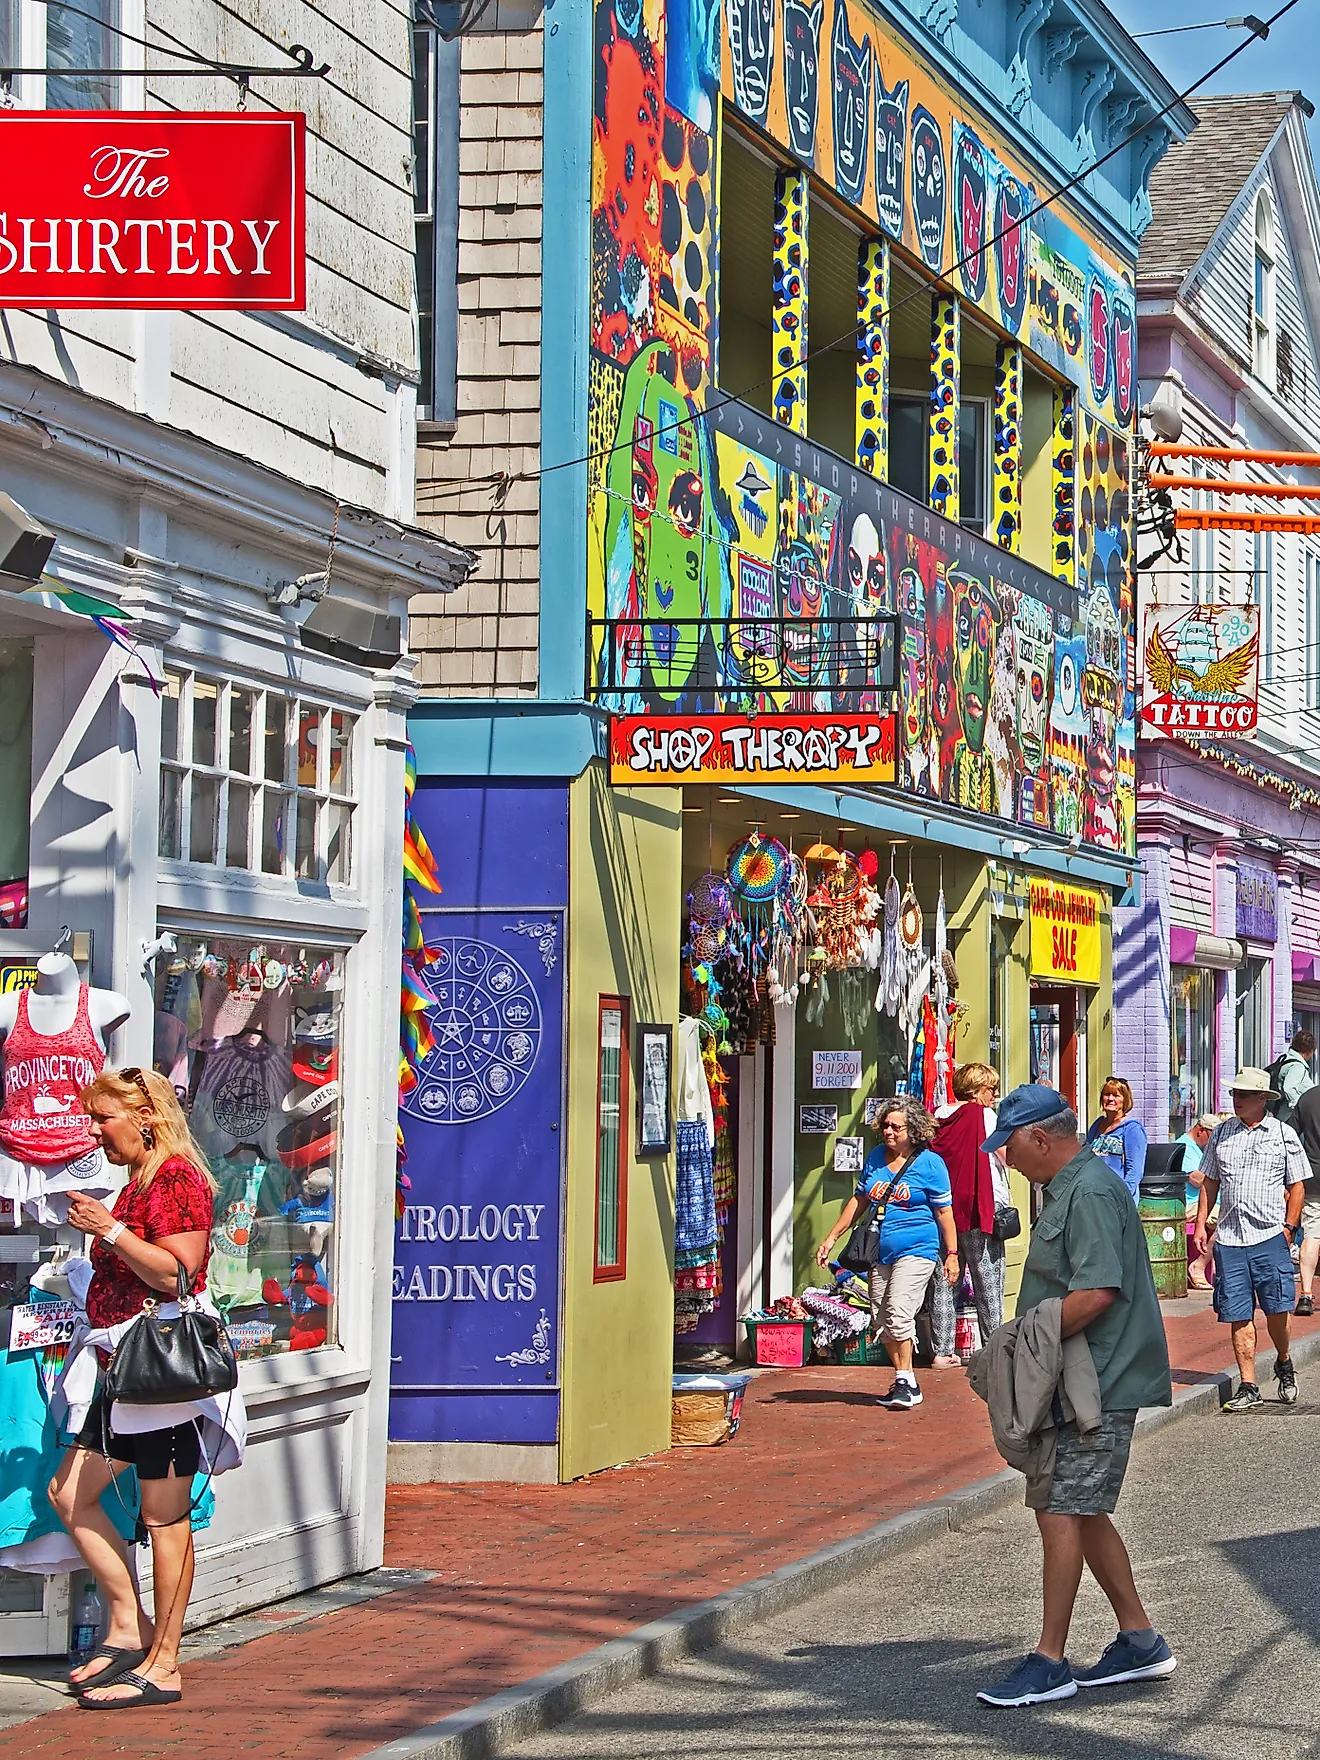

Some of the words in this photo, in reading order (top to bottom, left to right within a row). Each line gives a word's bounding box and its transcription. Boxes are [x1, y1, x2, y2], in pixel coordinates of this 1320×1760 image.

[83, 145, 170, 198] The
[0, 218, 280, 275] SHIRTERY
[795, 443, 859, 495] SHOP
[875, 488, 976, 562] THERAPY
[1151, 703, 1254, 728] TATTOO
[629, 726, 714, 772] SHOP
[720, 725, 881, 772] THERAPY
[1031, 883, 1050, 920] CAPE
[1052, 925, 1077, 972] SALE
[818, 1052, 850, 1062] NEVER
[815, 1075, 854, 1087] FORGET
[311, 1091, 327, 1109] CAPE
[400, 1204, 545, 1241] TROLOGY
[391, 1265, 537, 1301] EADINGS
[34, 1312, 73, 1323] SALE
